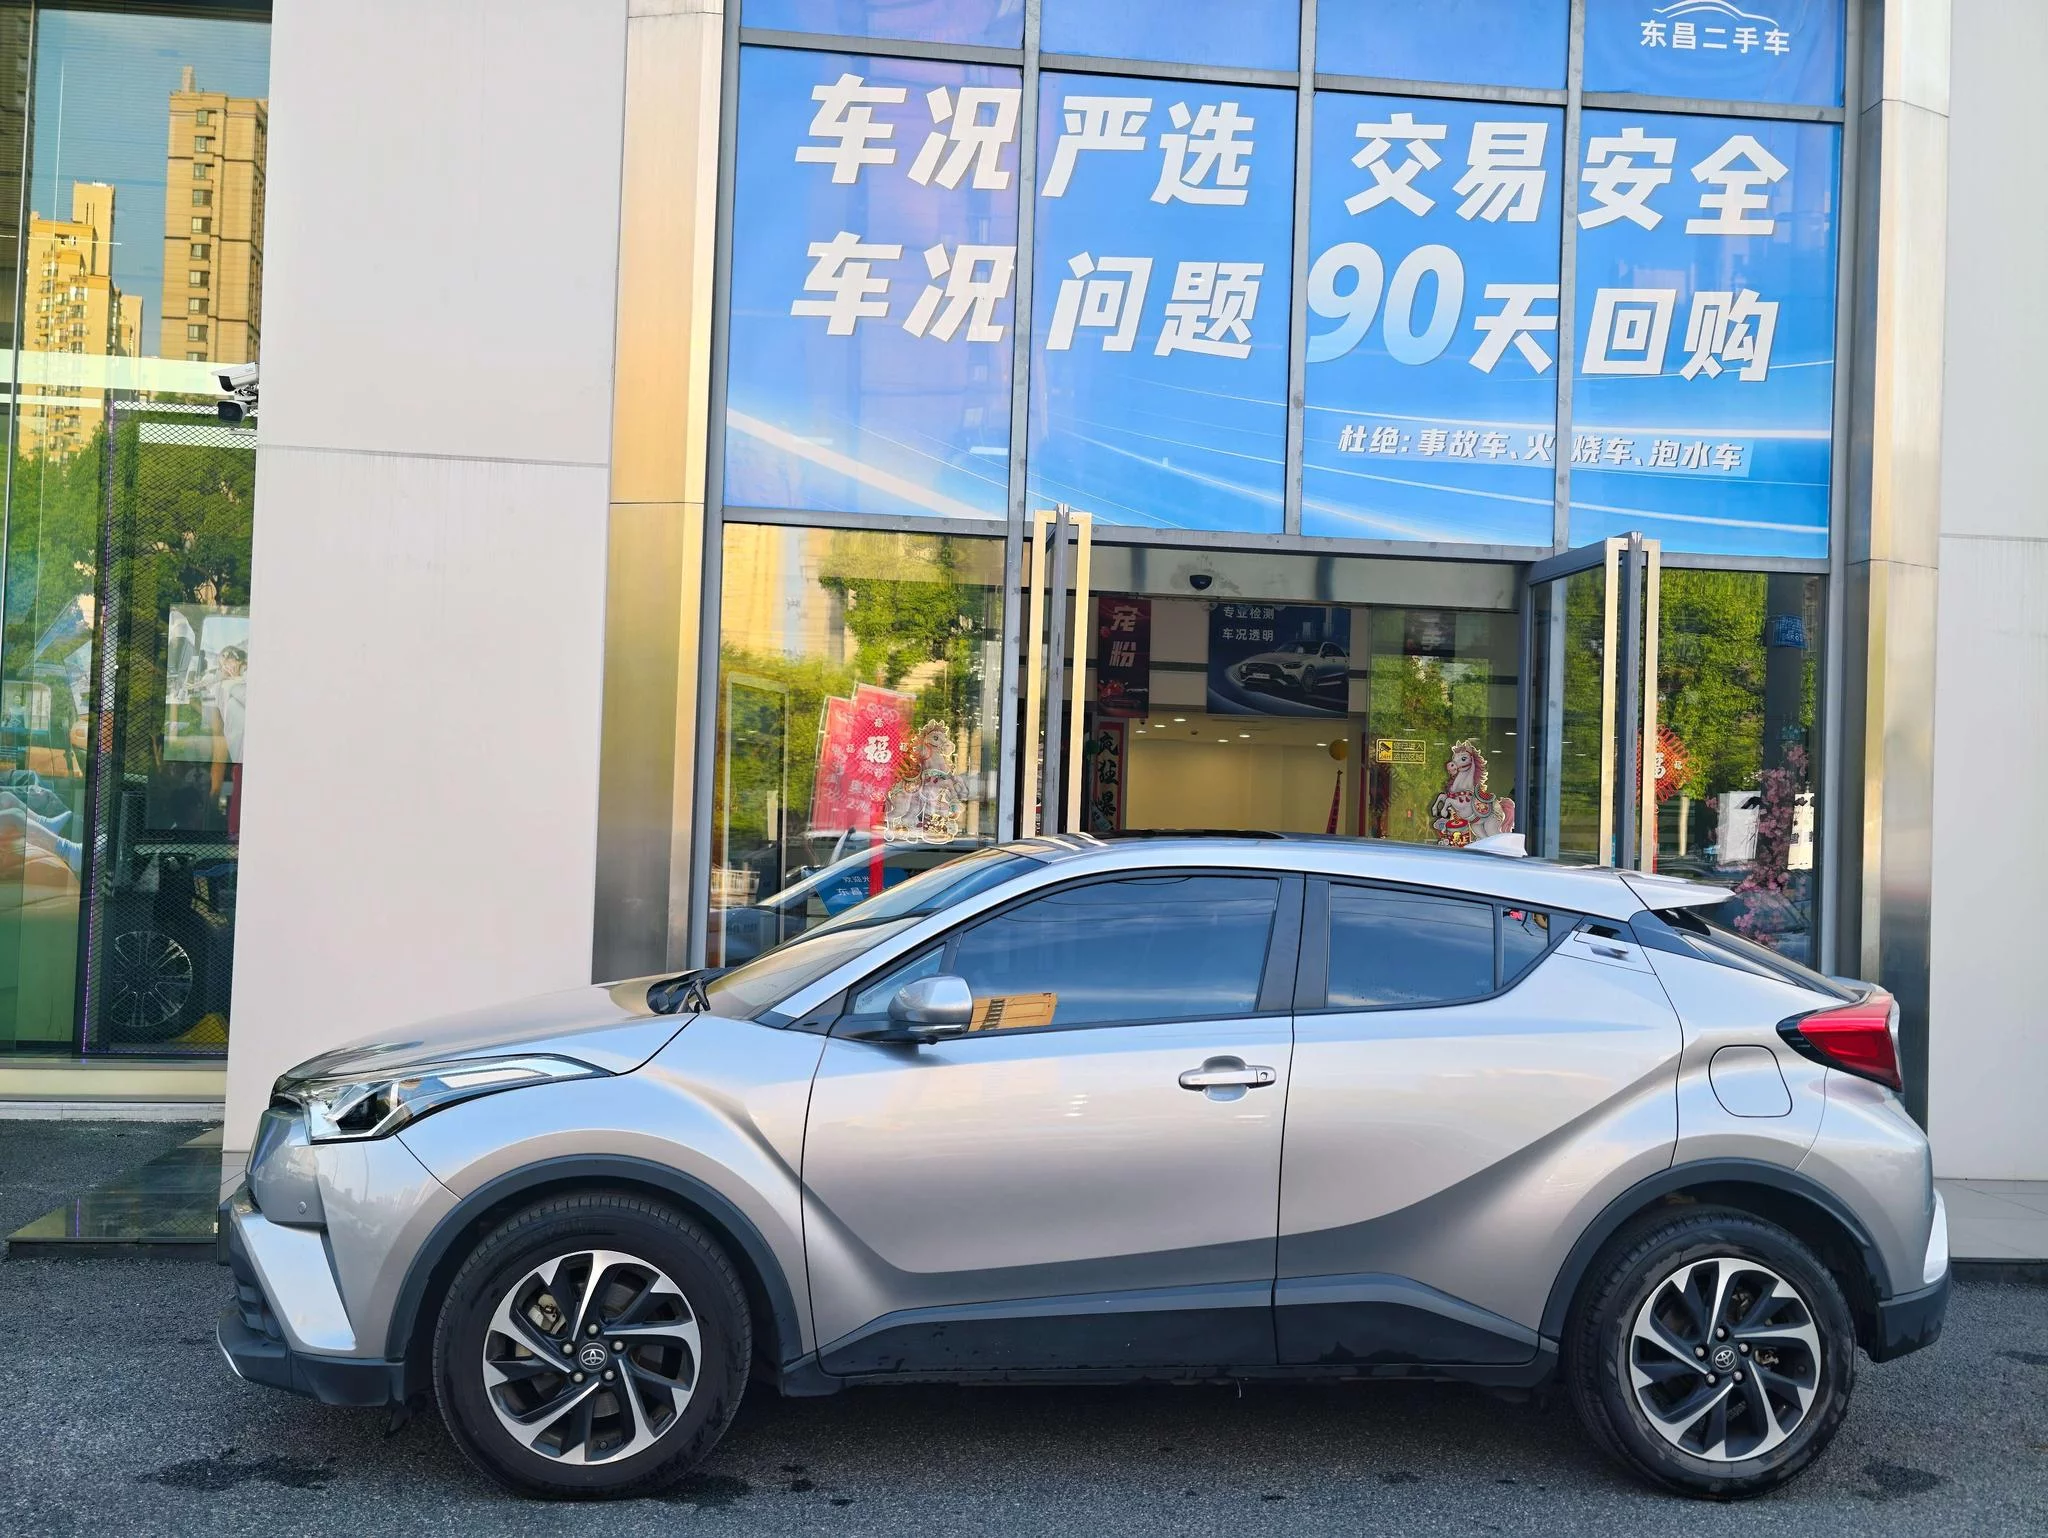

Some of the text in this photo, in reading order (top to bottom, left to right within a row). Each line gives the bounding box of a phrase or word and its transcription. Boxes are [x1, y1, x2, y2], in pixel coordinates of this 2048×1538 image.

[1640, 19, 1791, 56] 东昌二手车
[795, 73, 1789, 235] 车况严选 交易安全
[790, 231, 1779, 382] 车况问题 90天回购
[1109, 605, 1139, 668] 宠粉
[1222, 627, 1274, 643] 车况透明
[1223, 606, 1275, 621] 专业检测
